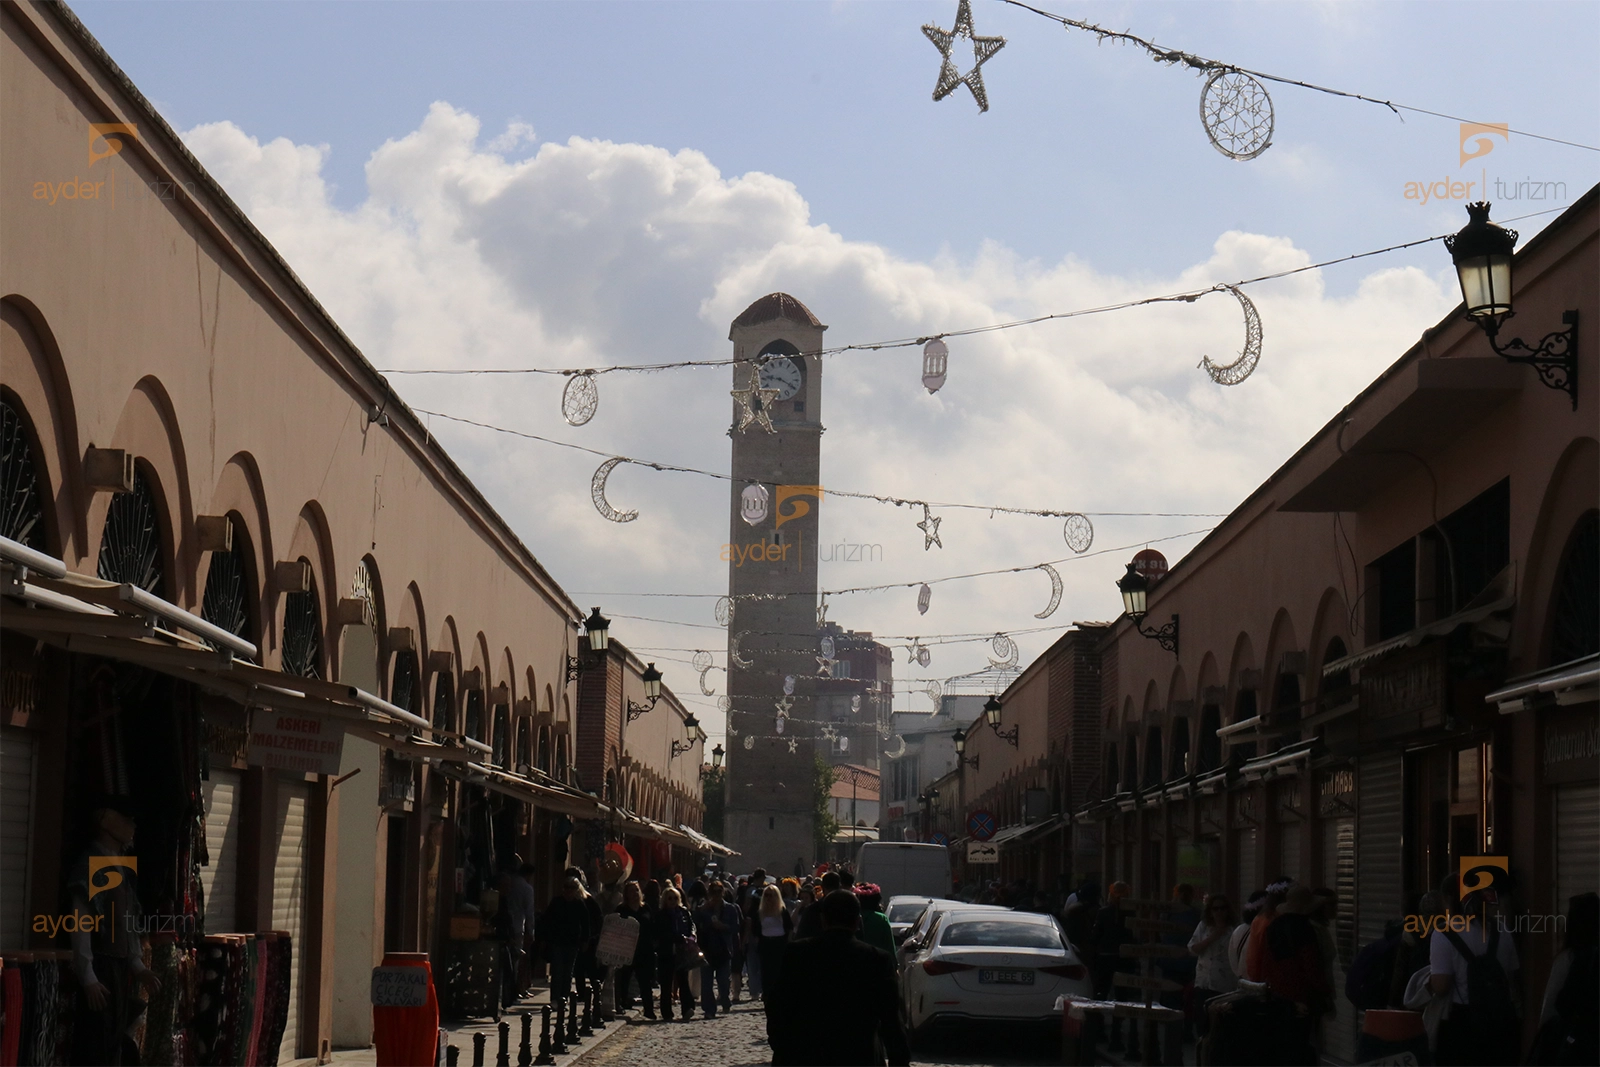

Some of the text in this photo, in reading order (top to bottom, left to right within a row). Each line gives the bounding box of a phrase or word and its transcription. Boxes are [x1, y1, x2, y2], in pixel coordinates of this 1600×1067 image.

[372, 970, 427, 985] PORTAKAL
[984, 971, 1032, 982] 01 EEE 65
